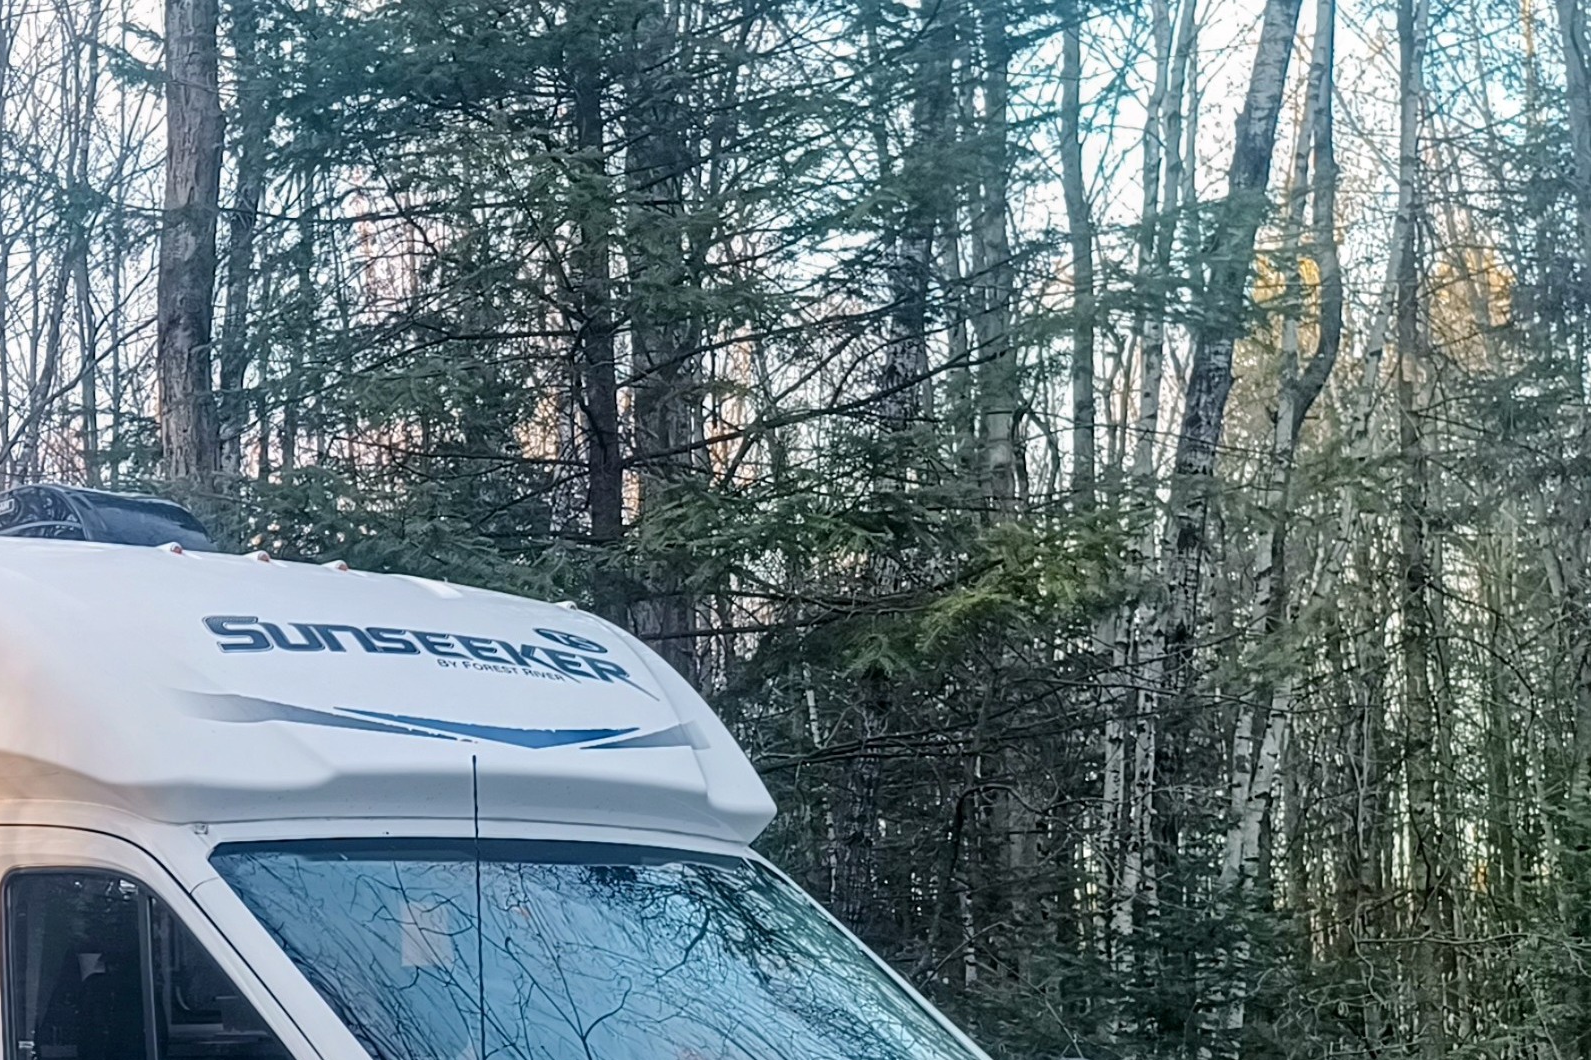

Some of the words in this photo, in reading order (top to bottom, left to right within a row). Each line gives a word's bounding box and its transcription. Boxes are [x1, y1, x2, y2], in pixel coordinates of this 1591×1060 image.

[437, 658, 458, 669] BY
[462, 661, 519, 676] FOREST
[523, 668, 566, 682] RIVER
